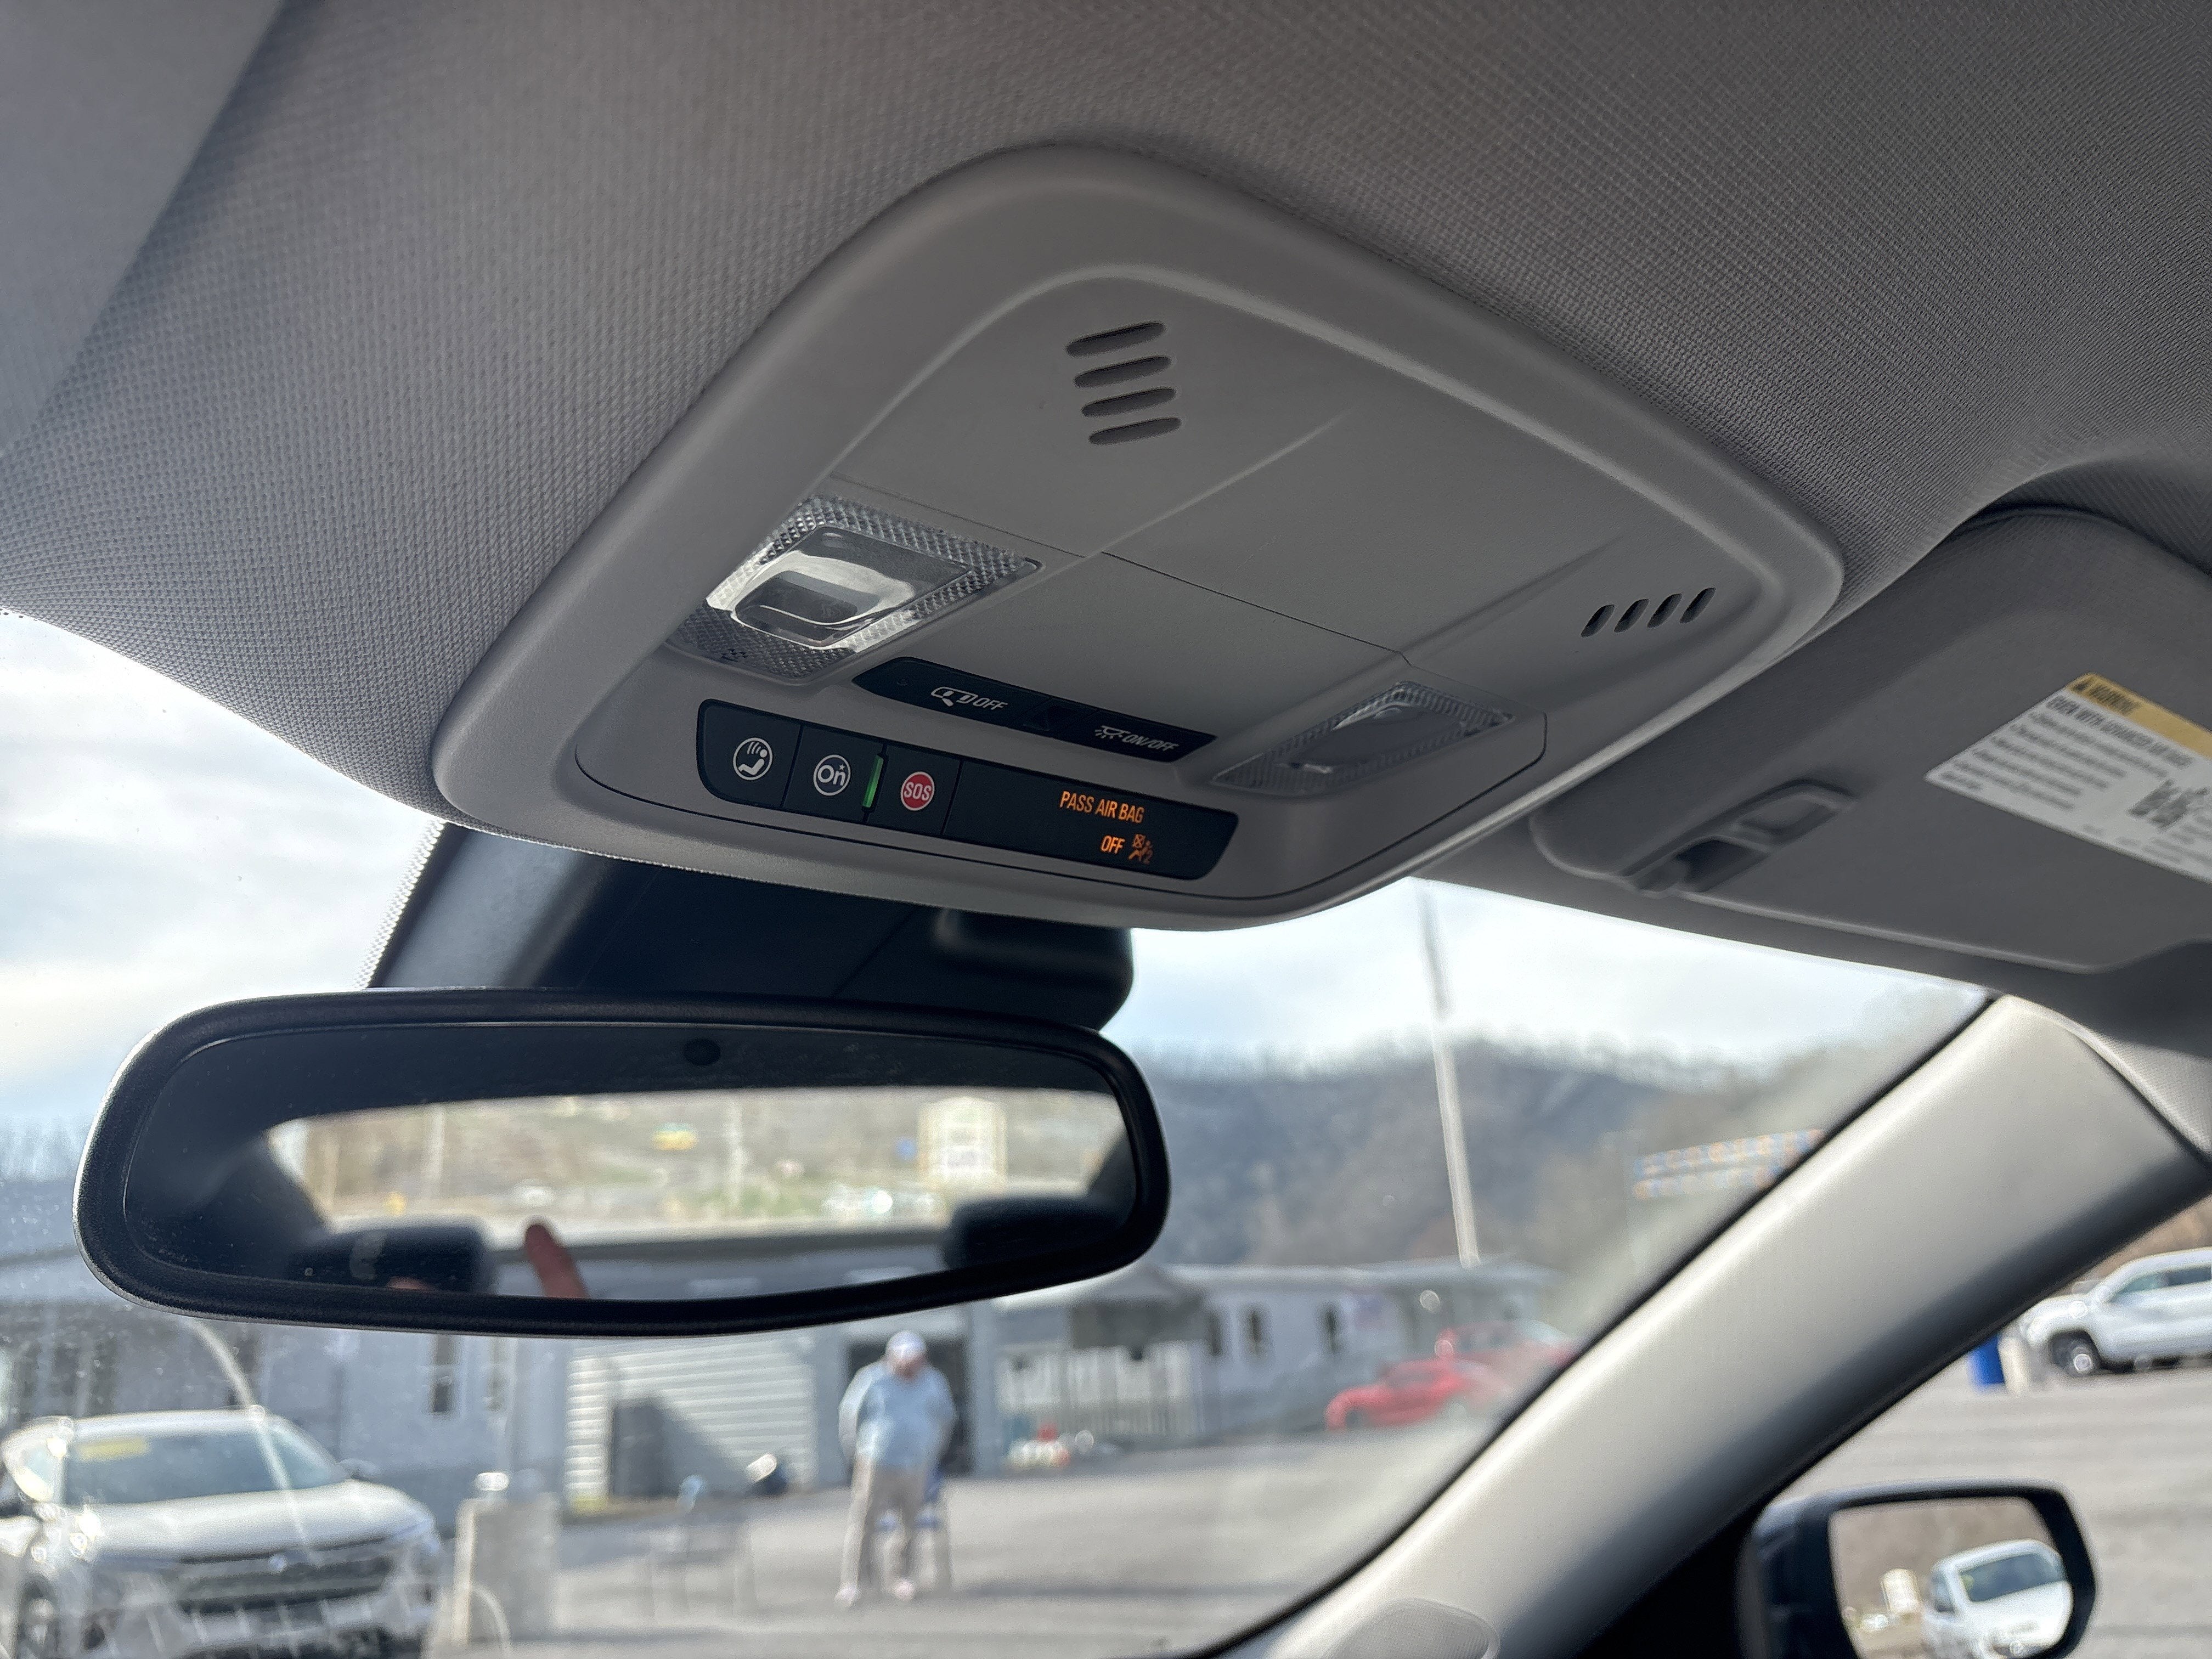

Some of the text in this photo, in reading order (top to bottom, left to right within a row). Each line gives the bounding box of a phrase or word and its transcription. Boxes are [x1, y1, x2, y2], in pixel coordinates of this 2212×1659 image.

[973, 698, 1008, 710] OFF
[1122, 734, 1179, 751] ON/OFF
[817, 765, 846, 786] On
[904, 782, 932, 801] SOS
[1059, 791, 1145, 823] PASS AIR BAG
[1101, 836, 1125, 854] OFF
